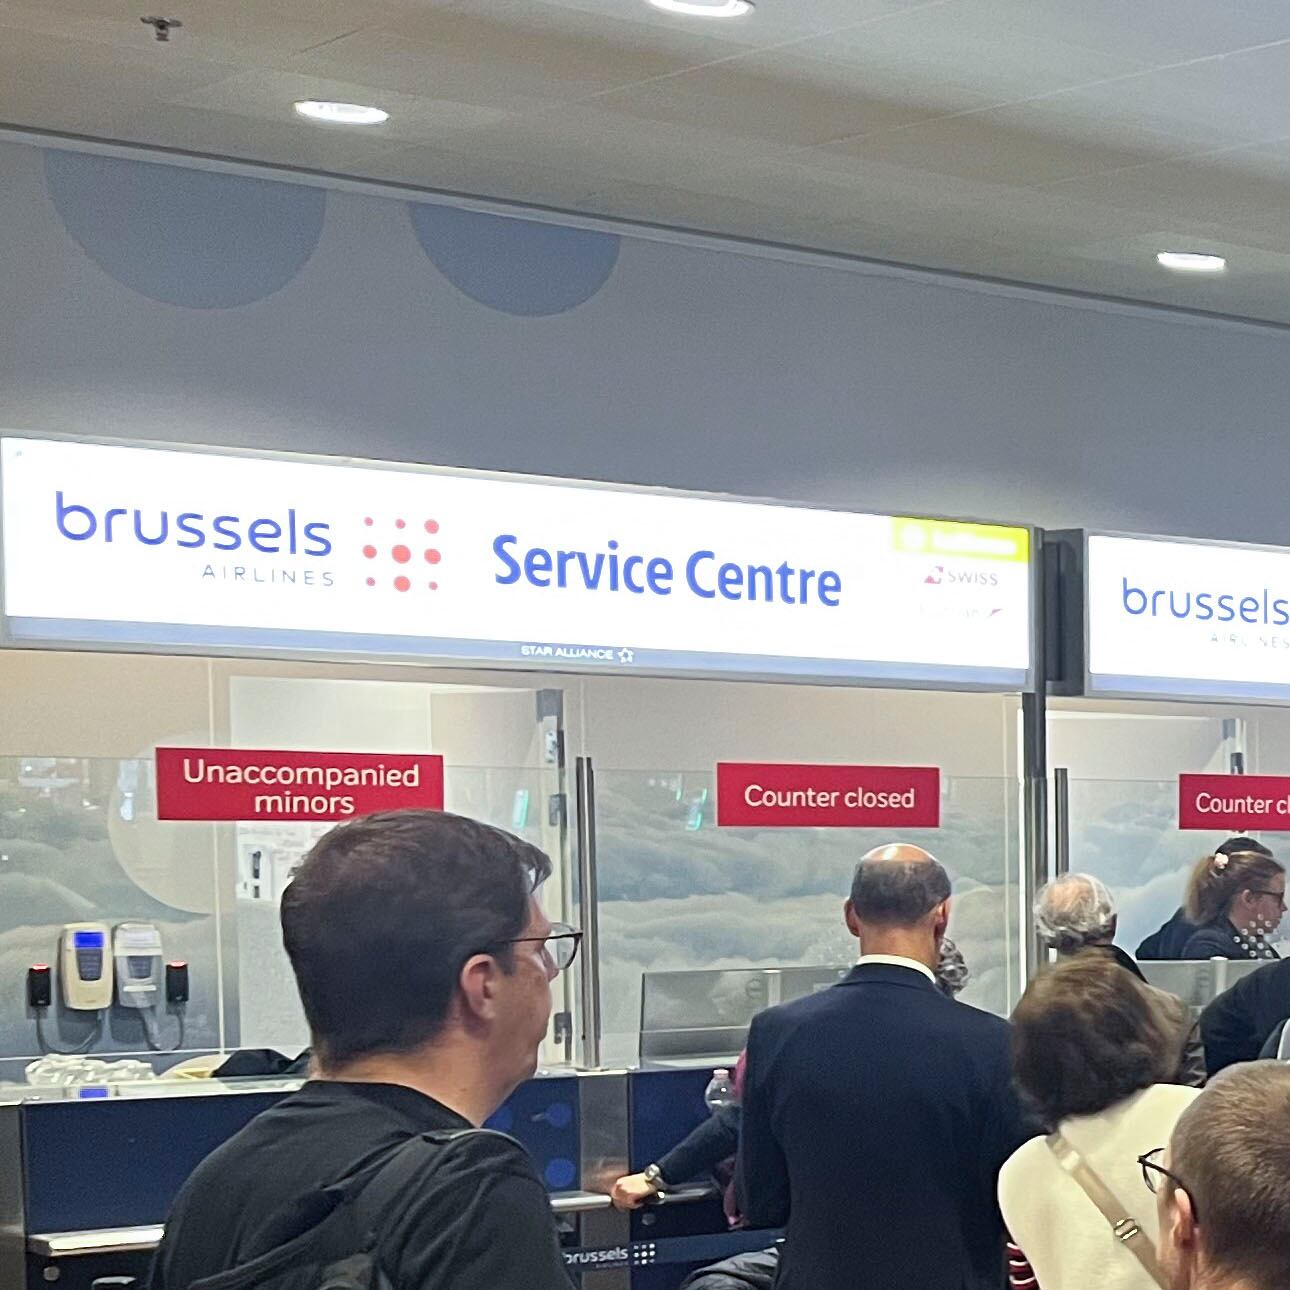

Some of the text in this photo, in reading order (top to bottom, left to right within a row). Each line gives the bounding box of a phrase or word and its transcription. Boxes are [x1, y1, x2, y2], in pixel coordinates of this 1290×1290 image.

[56, 491, 332, 556] brussels
[202, 564, 334, 586] AIRLINES
[493, 534, 842, 606] Service Centre
[948, 570, 999, 586] SWISS
[1122, 577, 1289, 625] brussels
[521, 645, 614, 660] STAR ALLIANCE
[183, 759, 420, 790] Unaccompanied
[255, 790, 355, 814] minors
[744, 784, 915, 808] Counter closed
[1196, 792, 1273, 814] Counter
